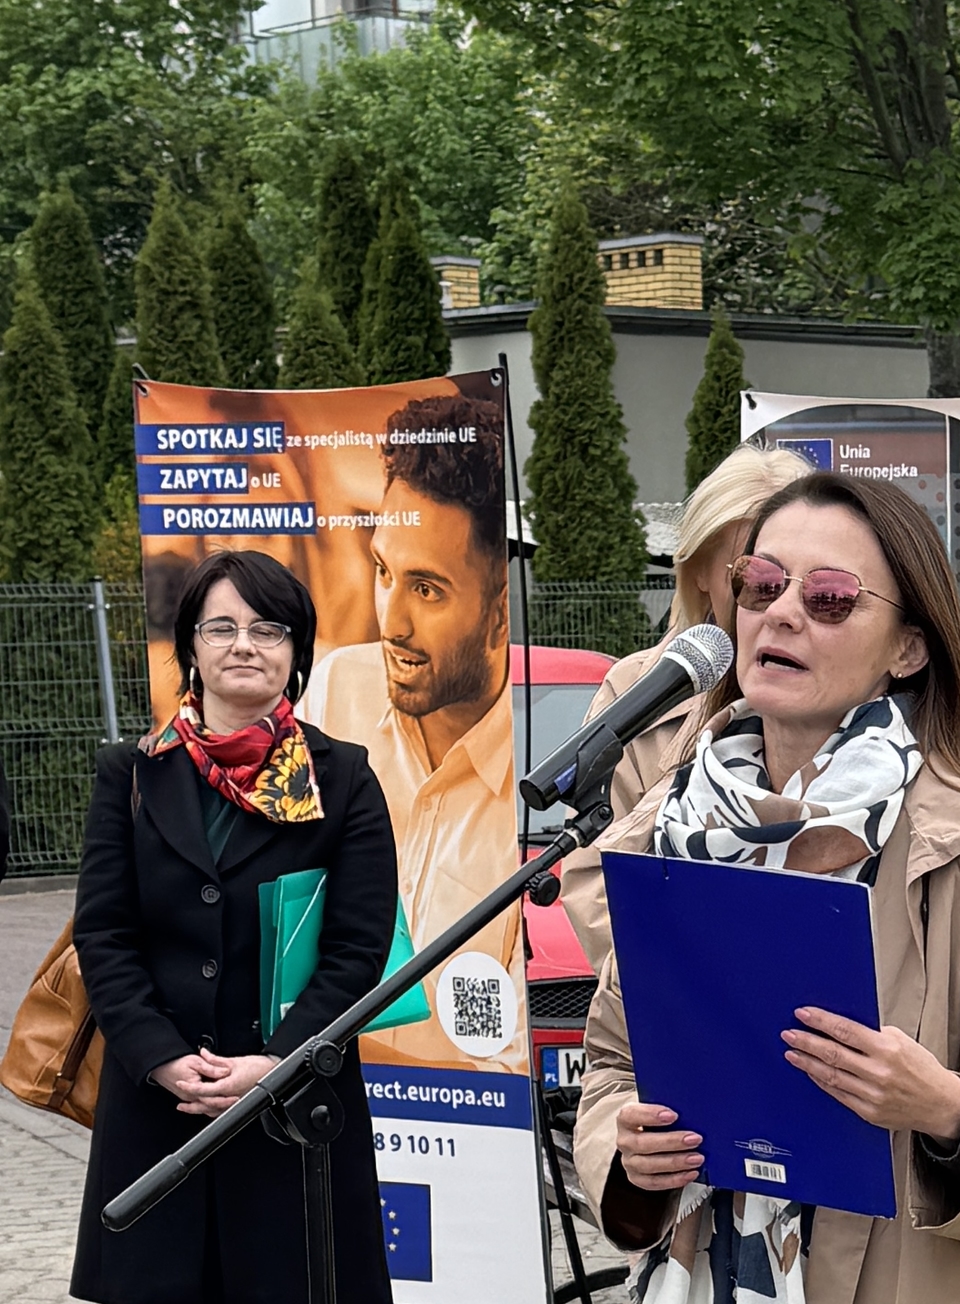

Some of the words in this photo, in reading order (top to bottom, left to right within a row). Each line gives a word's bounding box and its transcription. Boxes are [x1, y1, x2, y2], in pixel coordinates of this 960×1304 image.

[156, 428, 247, 450] SPOTKAJ
[252, 426, 284, 453] SIĘ
[286, 435, 302, 448] ze
[304, 430, 375, 450] specjalistą
[376, 432, 388, 446] w
[389, 428, 457, 446] dziedzinie
[458, 427, 477, 444] UE
[839, 444, 871, 459] Unia
[160, 468, 248, 490] ZAPYTAJ
[251, 475, 261, 489] o
[262, 472, 282, 488] UE
[840, 463, 918, 482] Europejska
[163, 507, 314, 529] POROZMAWIAJ
[317, 515, 327, 528] o
[328, 511, 400, 531] przyszłości
[402, 511, 421, 527] UE
[545, 1072, 558, 1083] PL
[389, 1133, 402, 1152] 9
[407, 1135, 430, 1155] 10
[434, 1137, 456, 1157] 11
